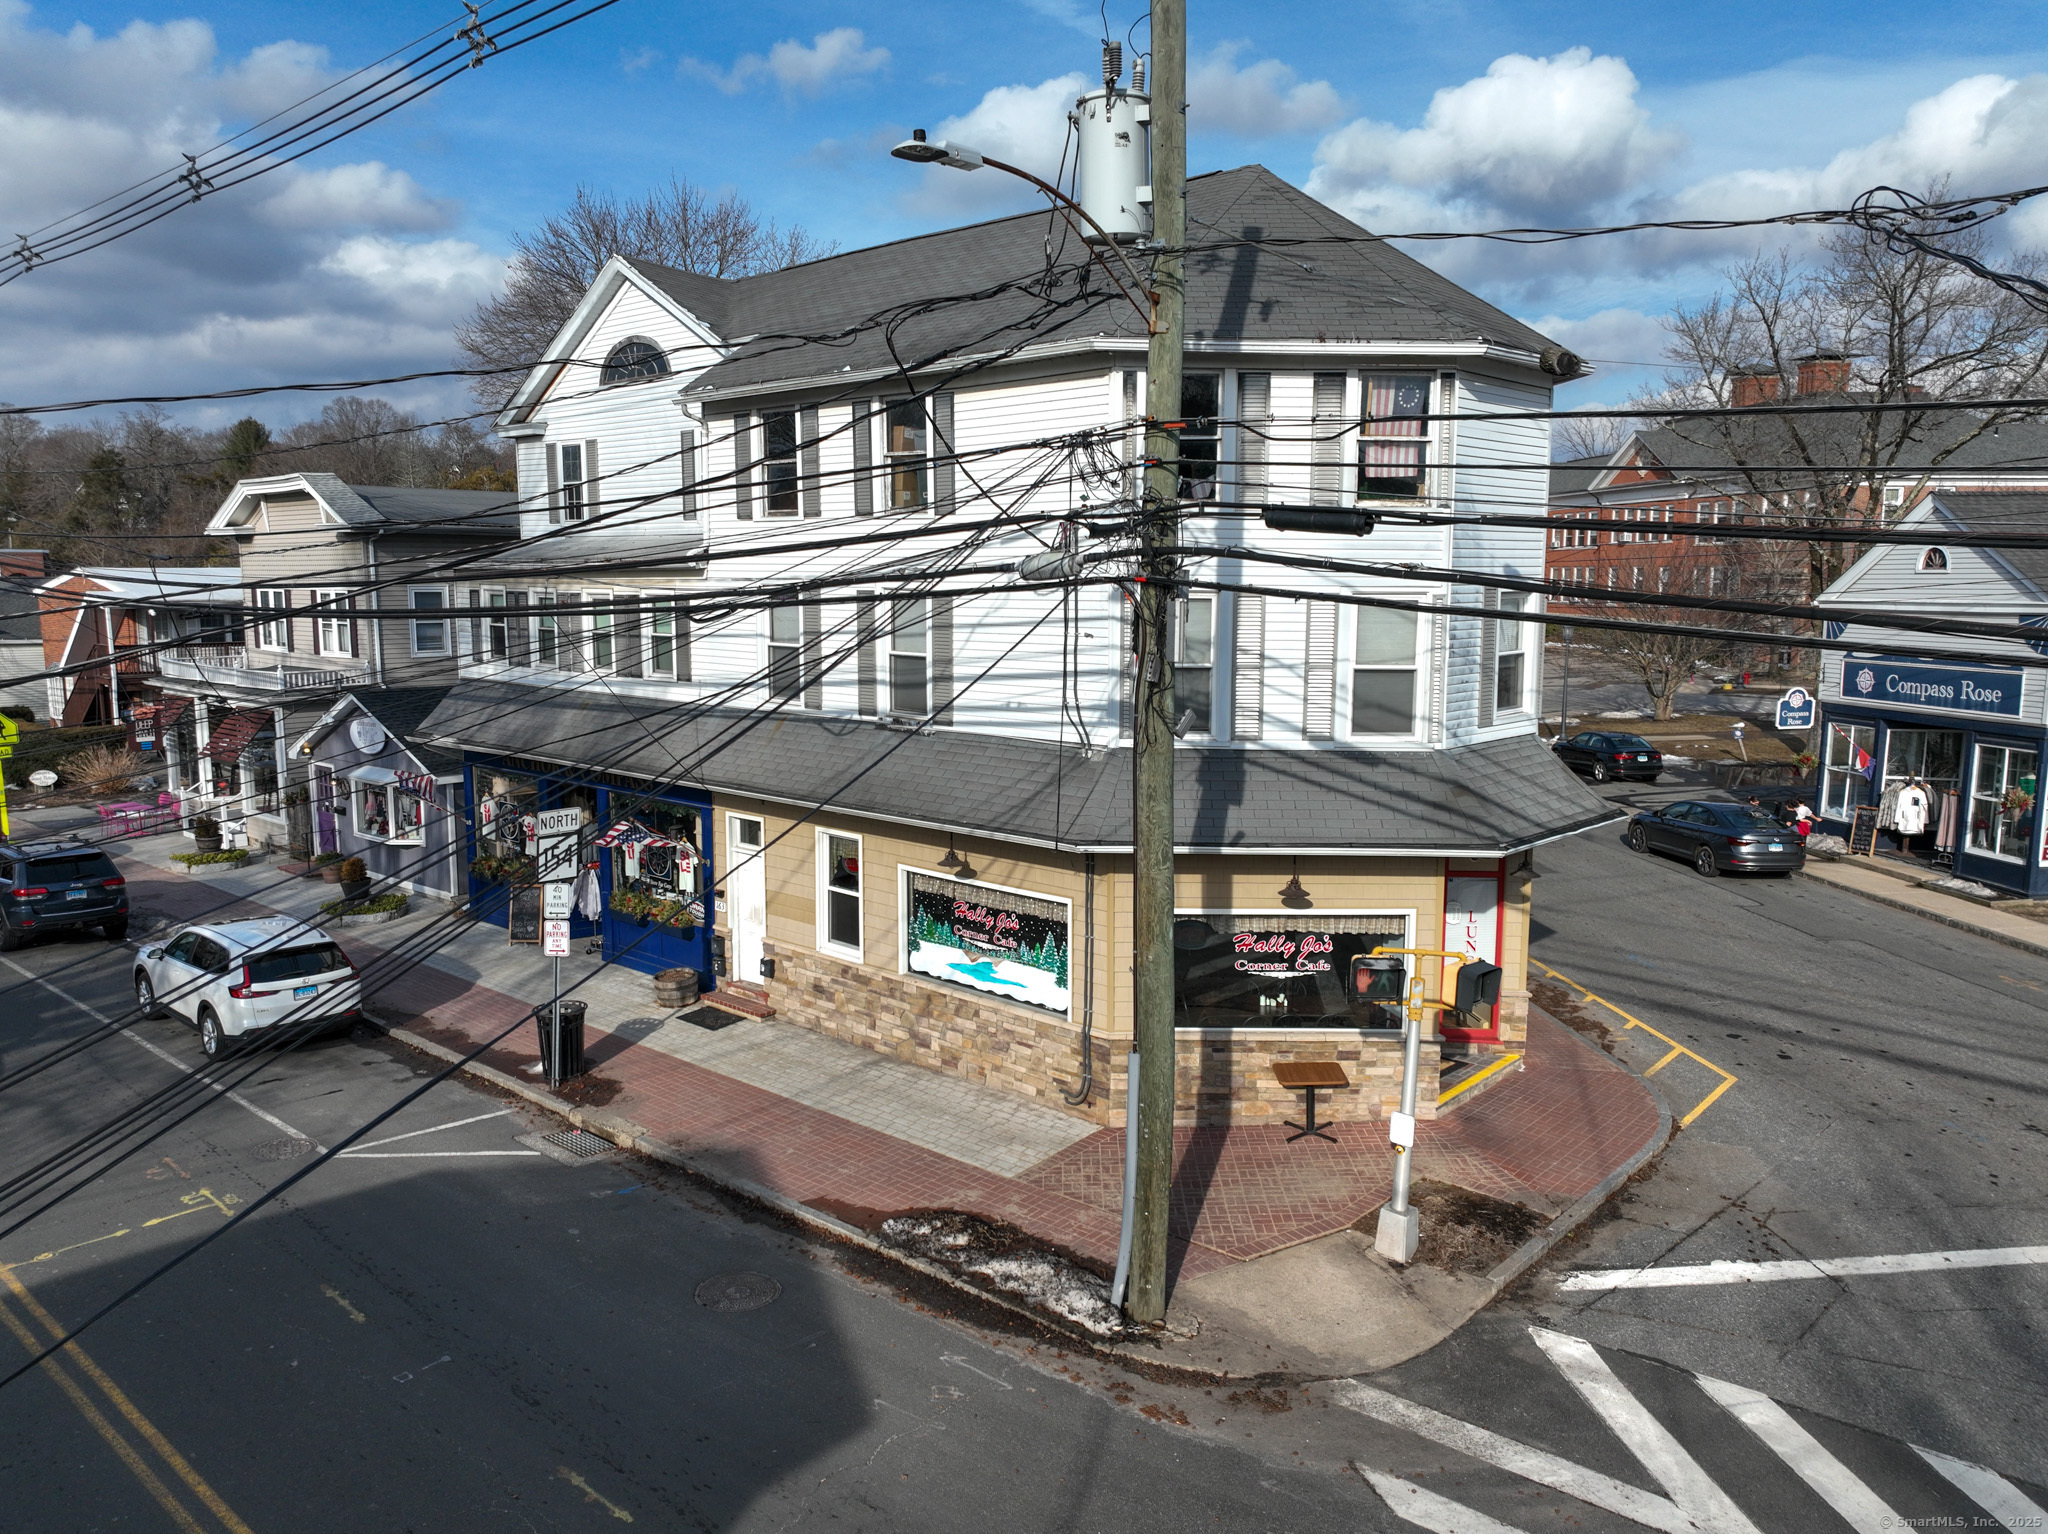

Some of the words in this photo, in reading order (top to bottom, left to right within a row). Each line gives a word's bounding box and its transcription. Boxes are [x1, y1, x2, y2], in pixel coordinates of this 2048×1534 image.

[1886, 674, 1954, 701] Compass
[1960, 680, 2002, 703] Rose
[1782, 710, 1810, 719] Compass
[540, 813, 578, 830] NORTH
[544, 844, 574, 872] 154
[553, 886, 562, 894] 40
[954, 901, 994, 930] Hally
[995, 912, 1020, 934] Jo's
[954, 925, 990, 942] Corner
[993, 934, 1018, 948] Cafe
[1232, 932, 1296, 959] Hally
[1297, 934, 1334, 961] Jo's
[1234, 960, 1288, 971] Corner
[1296, 959, 1331, 972] Cafe
